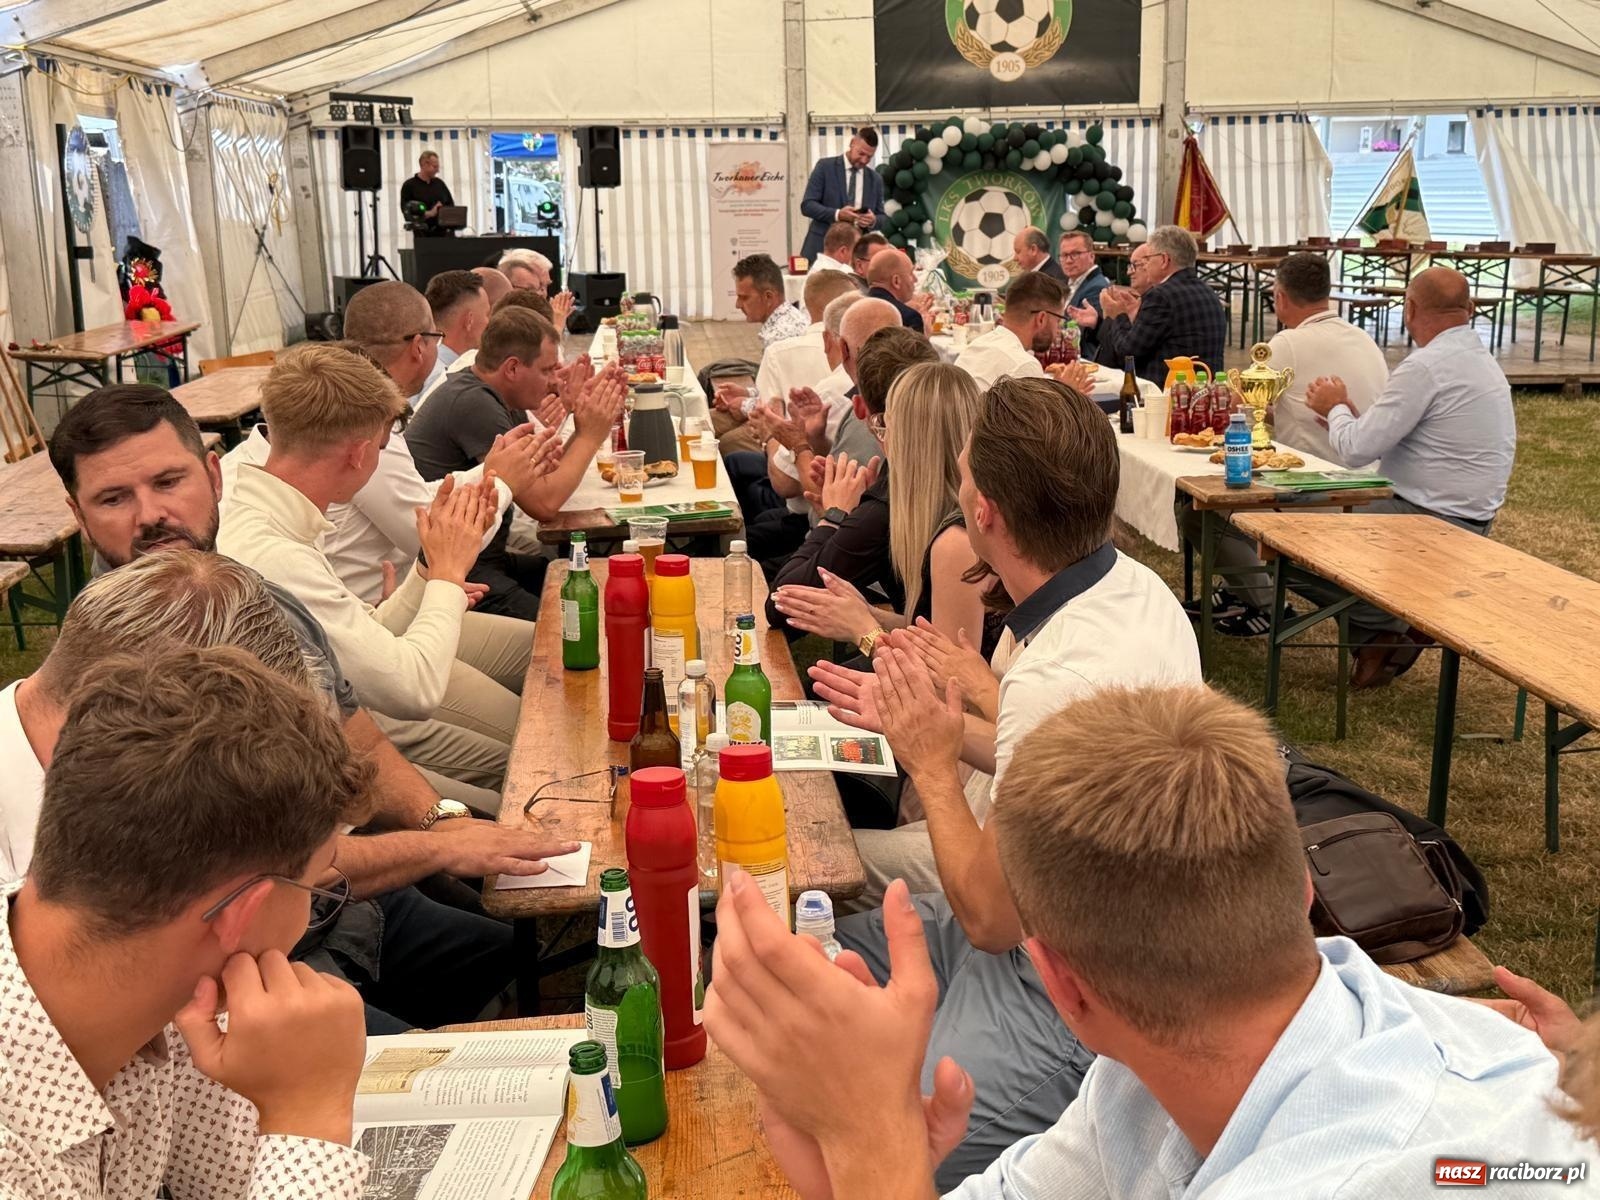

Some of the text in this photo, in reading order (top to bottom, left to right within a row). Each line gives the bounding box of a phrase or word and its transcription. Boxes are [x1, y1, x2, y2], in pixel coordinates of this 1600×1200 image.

[996, 60, 1021, 73] 1905
[939, 191, 960, 223] LKS
[983, 270, 1006, 282] 1905
